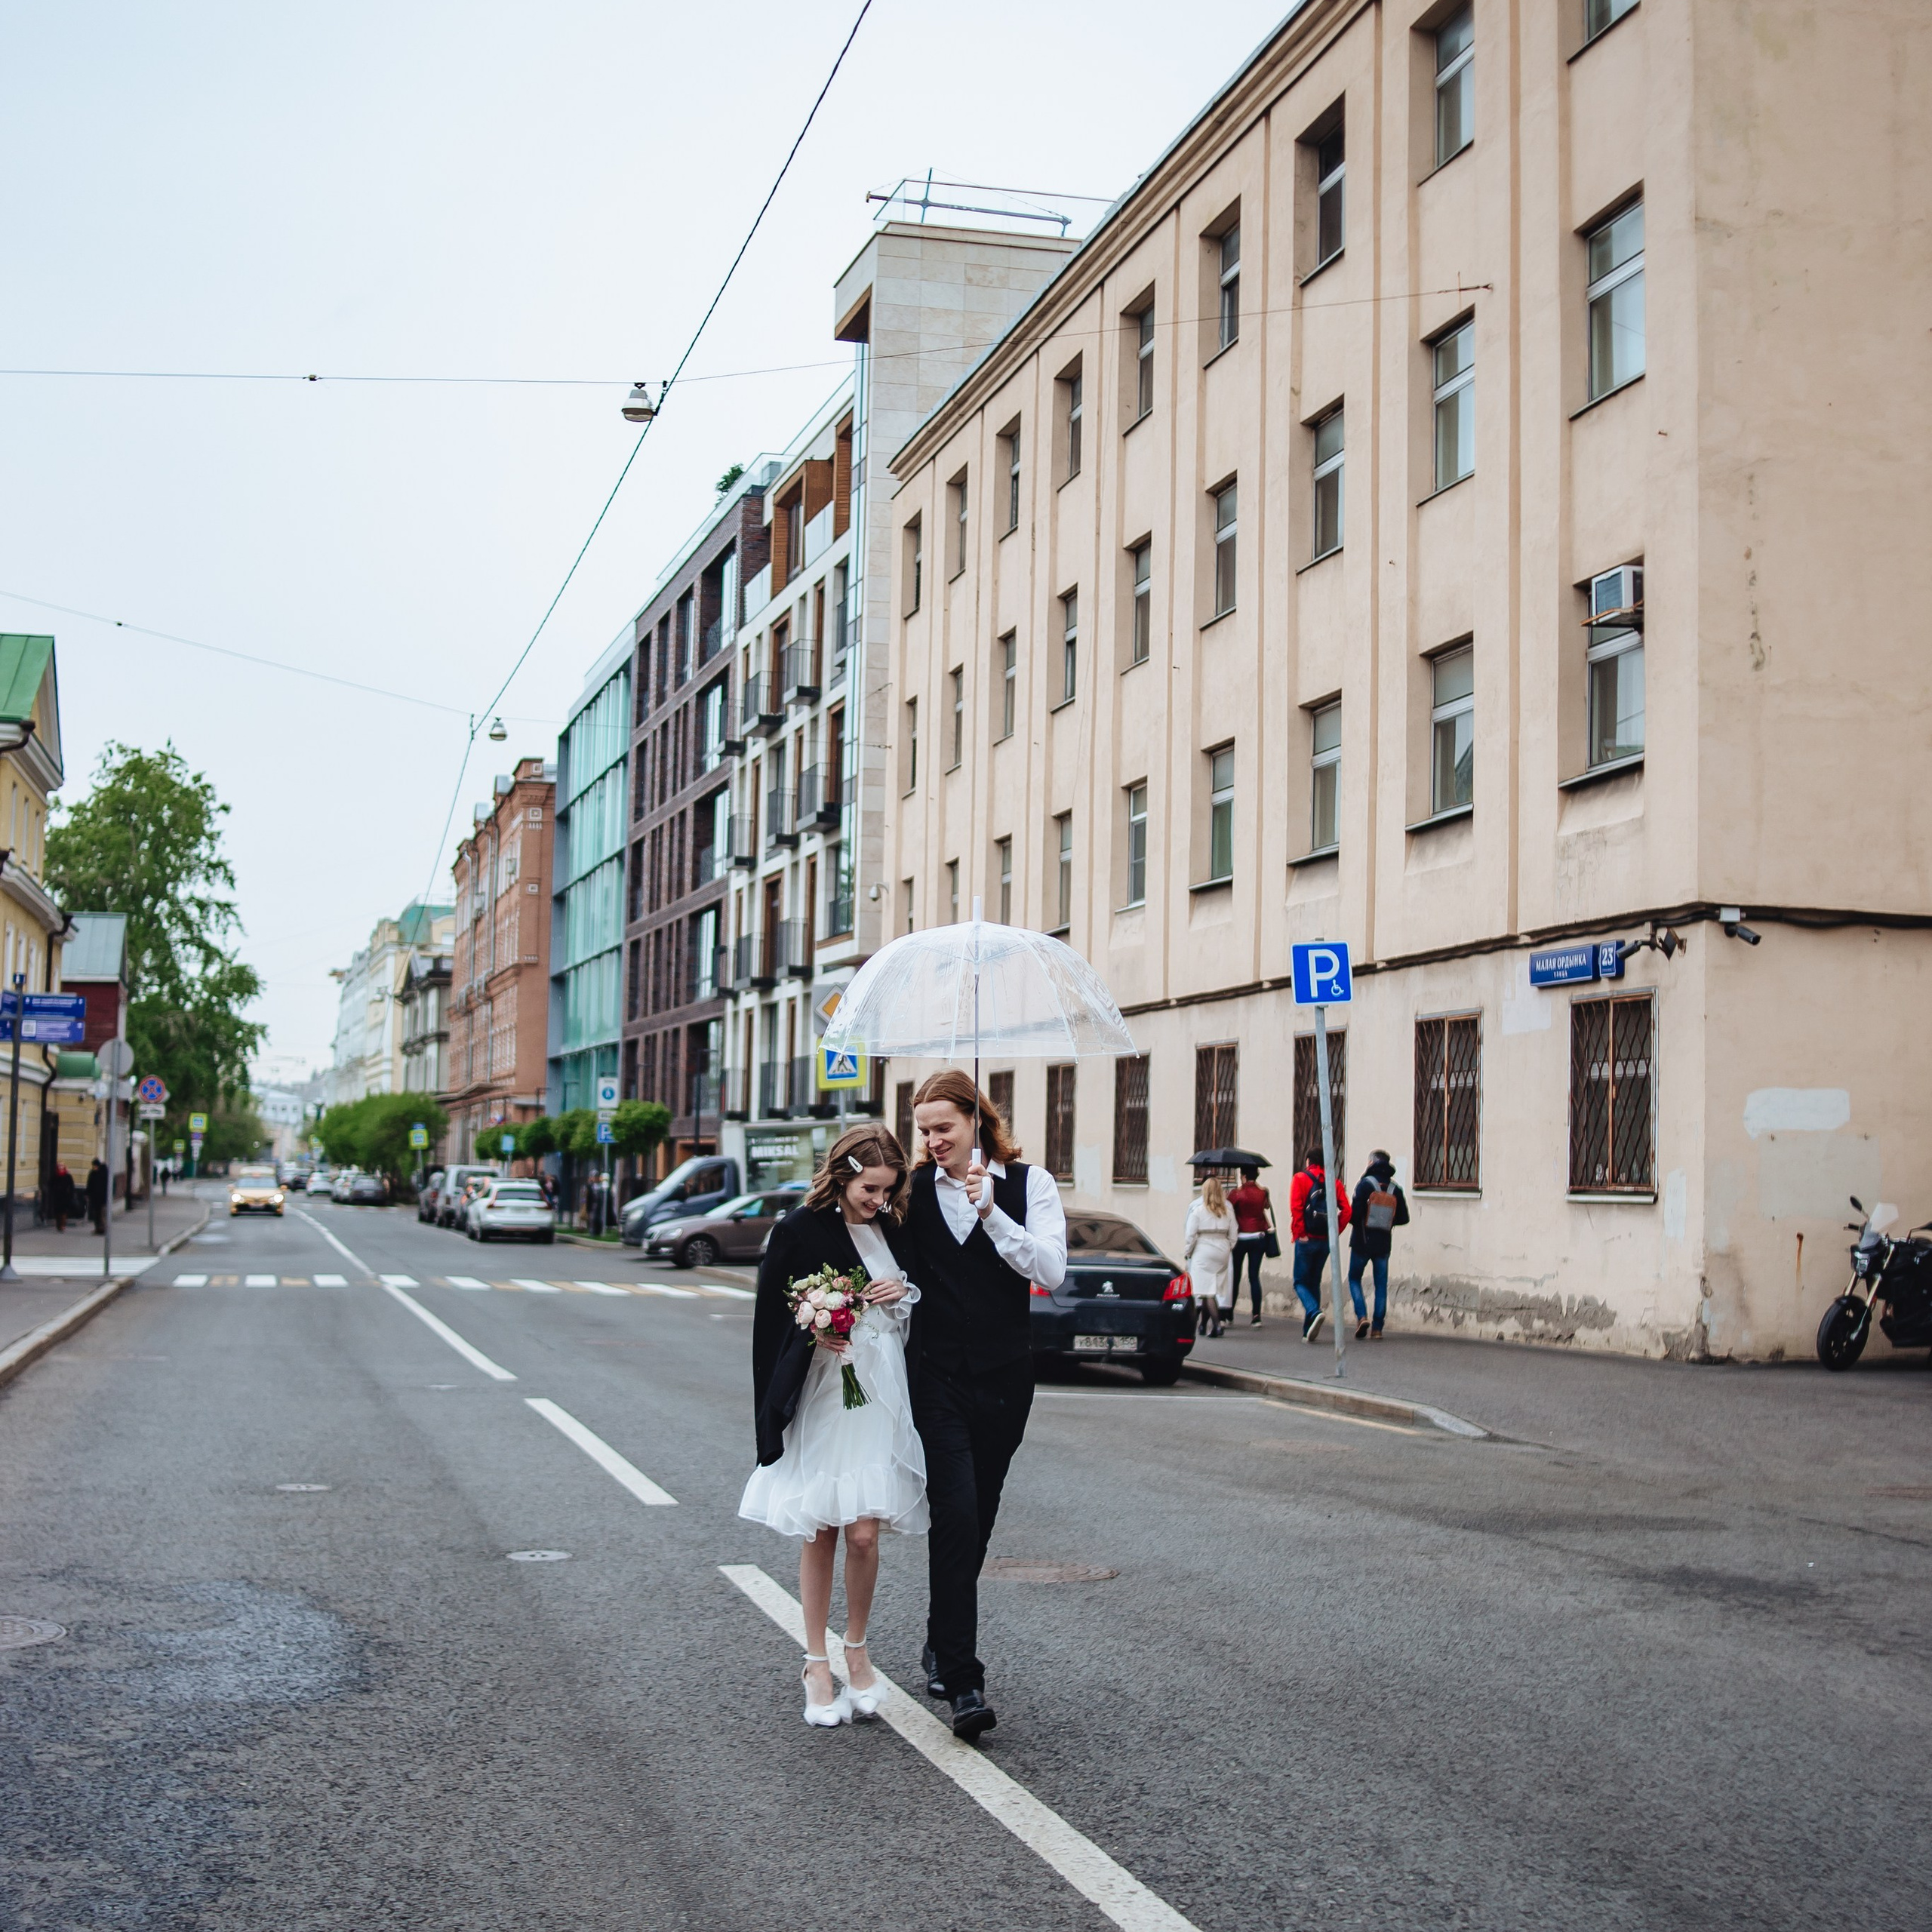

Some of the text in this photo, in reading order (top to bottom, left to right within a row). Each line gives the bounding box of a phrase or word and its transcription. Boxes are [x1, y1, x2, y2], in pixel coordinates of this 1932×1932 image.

[1536, 952, 1586, 972] МАЛАЯ ОРДЫНКА
[1601, 947, 1614, 966] 23
[1308, 949, 1340, 998] P
